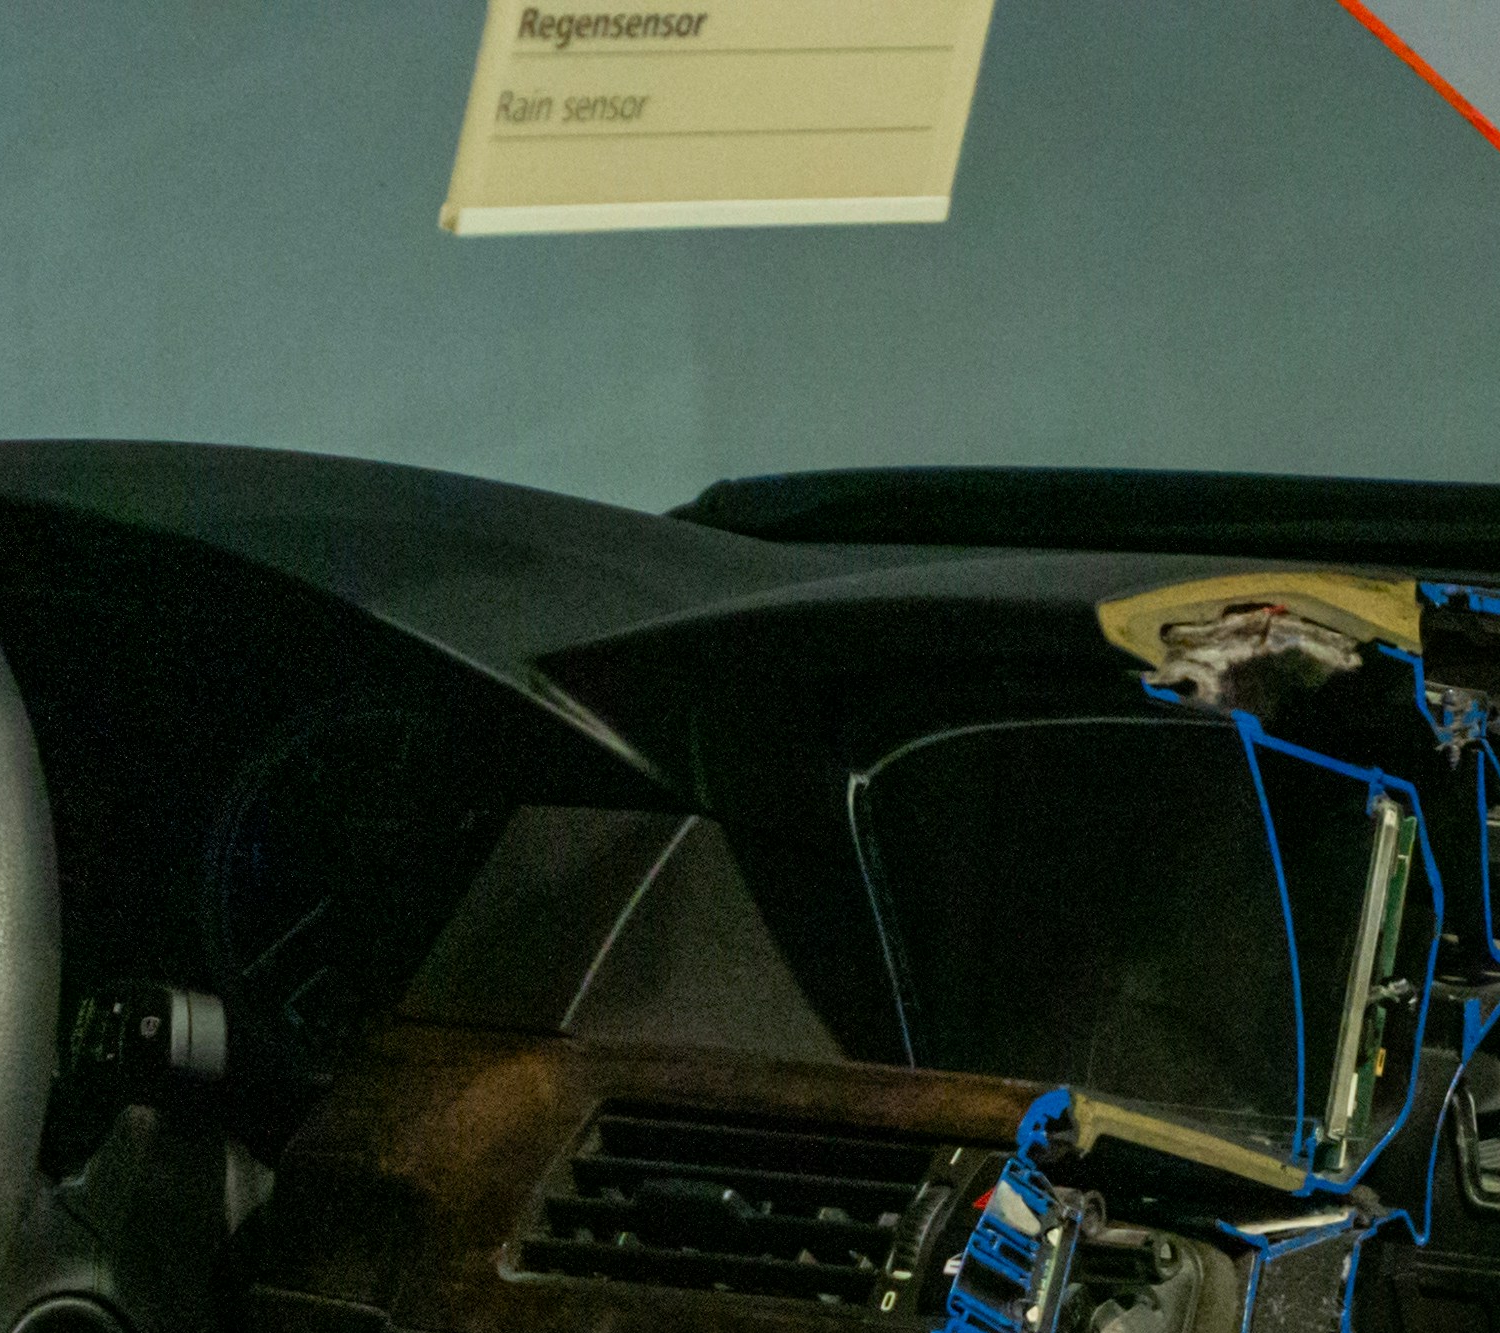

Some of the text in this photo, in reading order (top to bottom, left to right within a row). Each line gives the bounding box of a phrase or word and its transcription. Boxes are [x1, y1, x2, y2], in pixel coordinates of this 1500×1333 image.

[517, 8, 707, 49] Regensensor
[495, 89, 650, 122] Rain sensor
